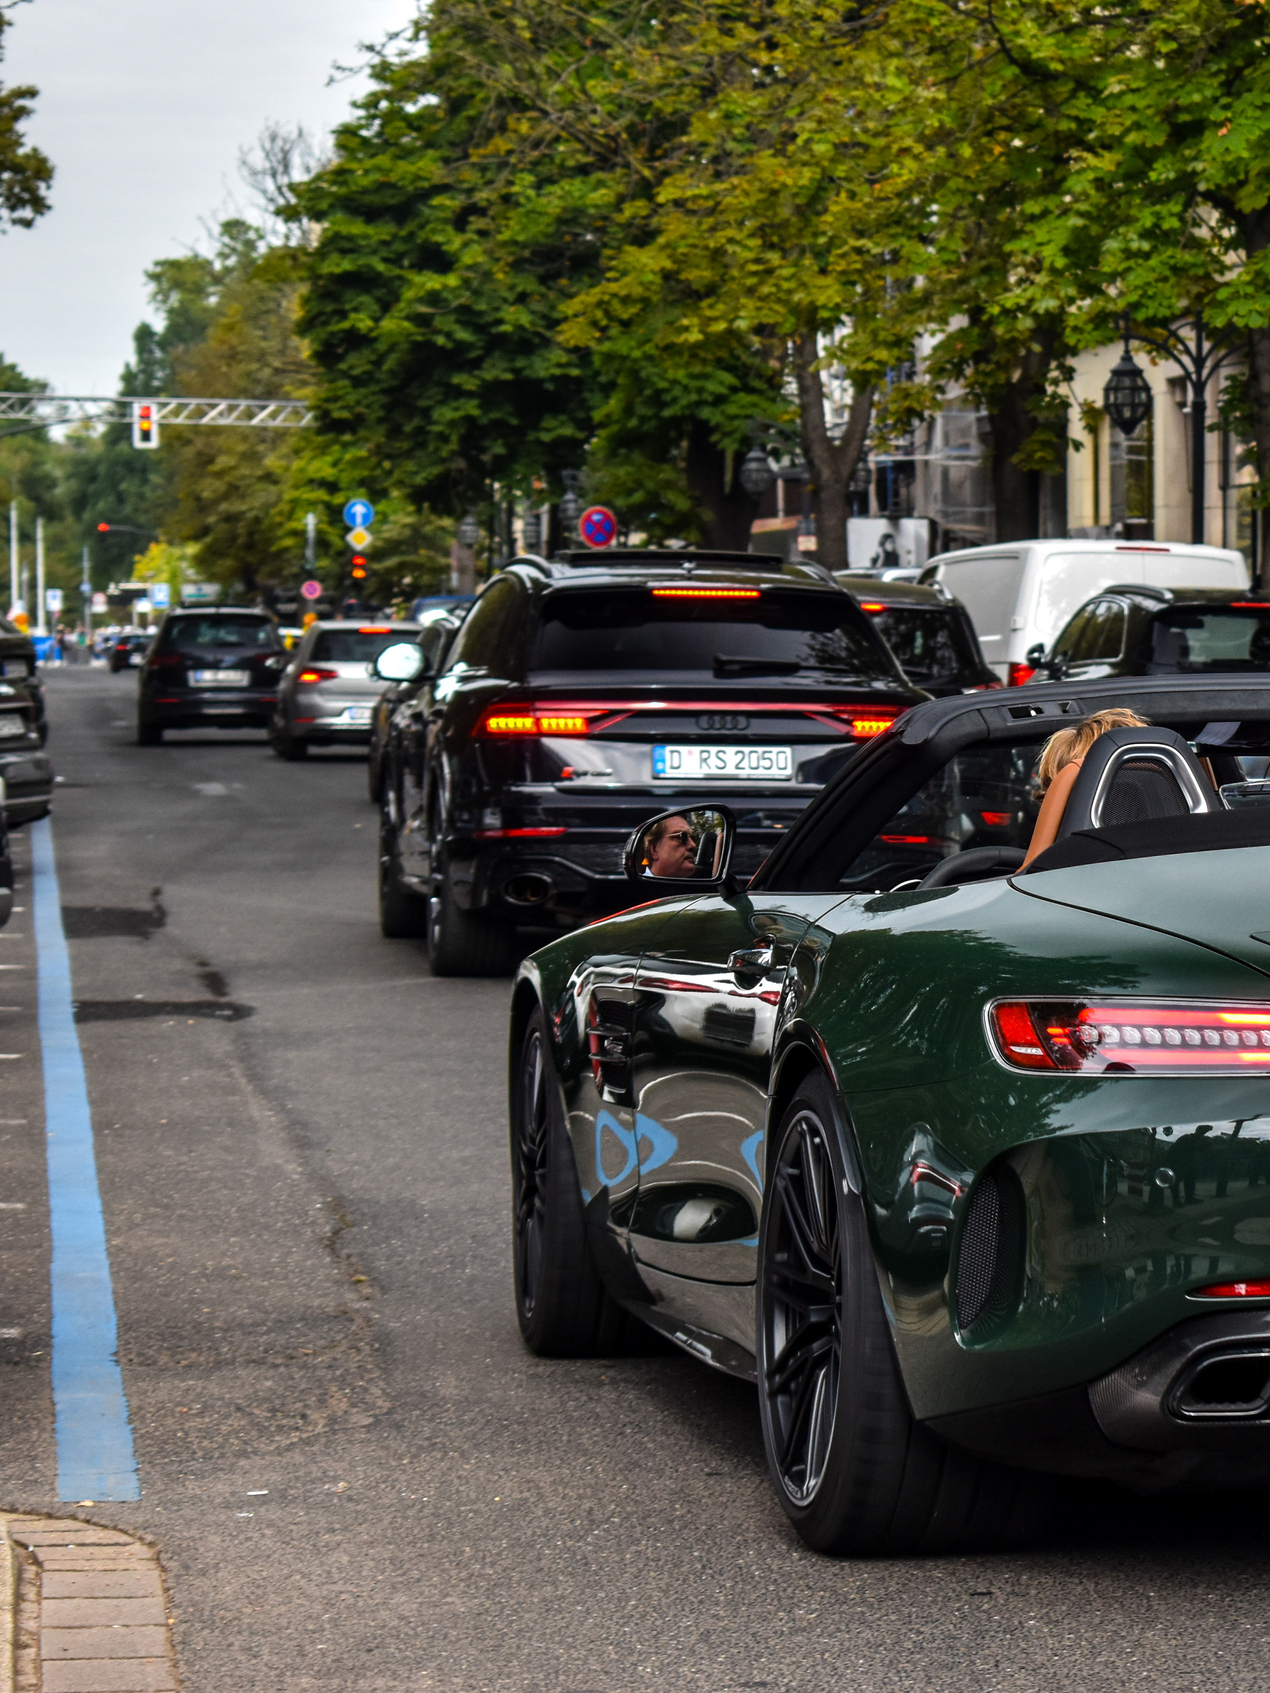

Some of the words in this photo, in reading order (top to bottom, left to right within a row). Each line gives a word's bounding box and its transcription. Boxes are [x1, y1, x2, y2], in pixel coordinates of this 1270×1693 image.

[668, 749, 682, 770] D
[699, 749, 728, 770] RS
[734, 750, 788, 771] 2050
